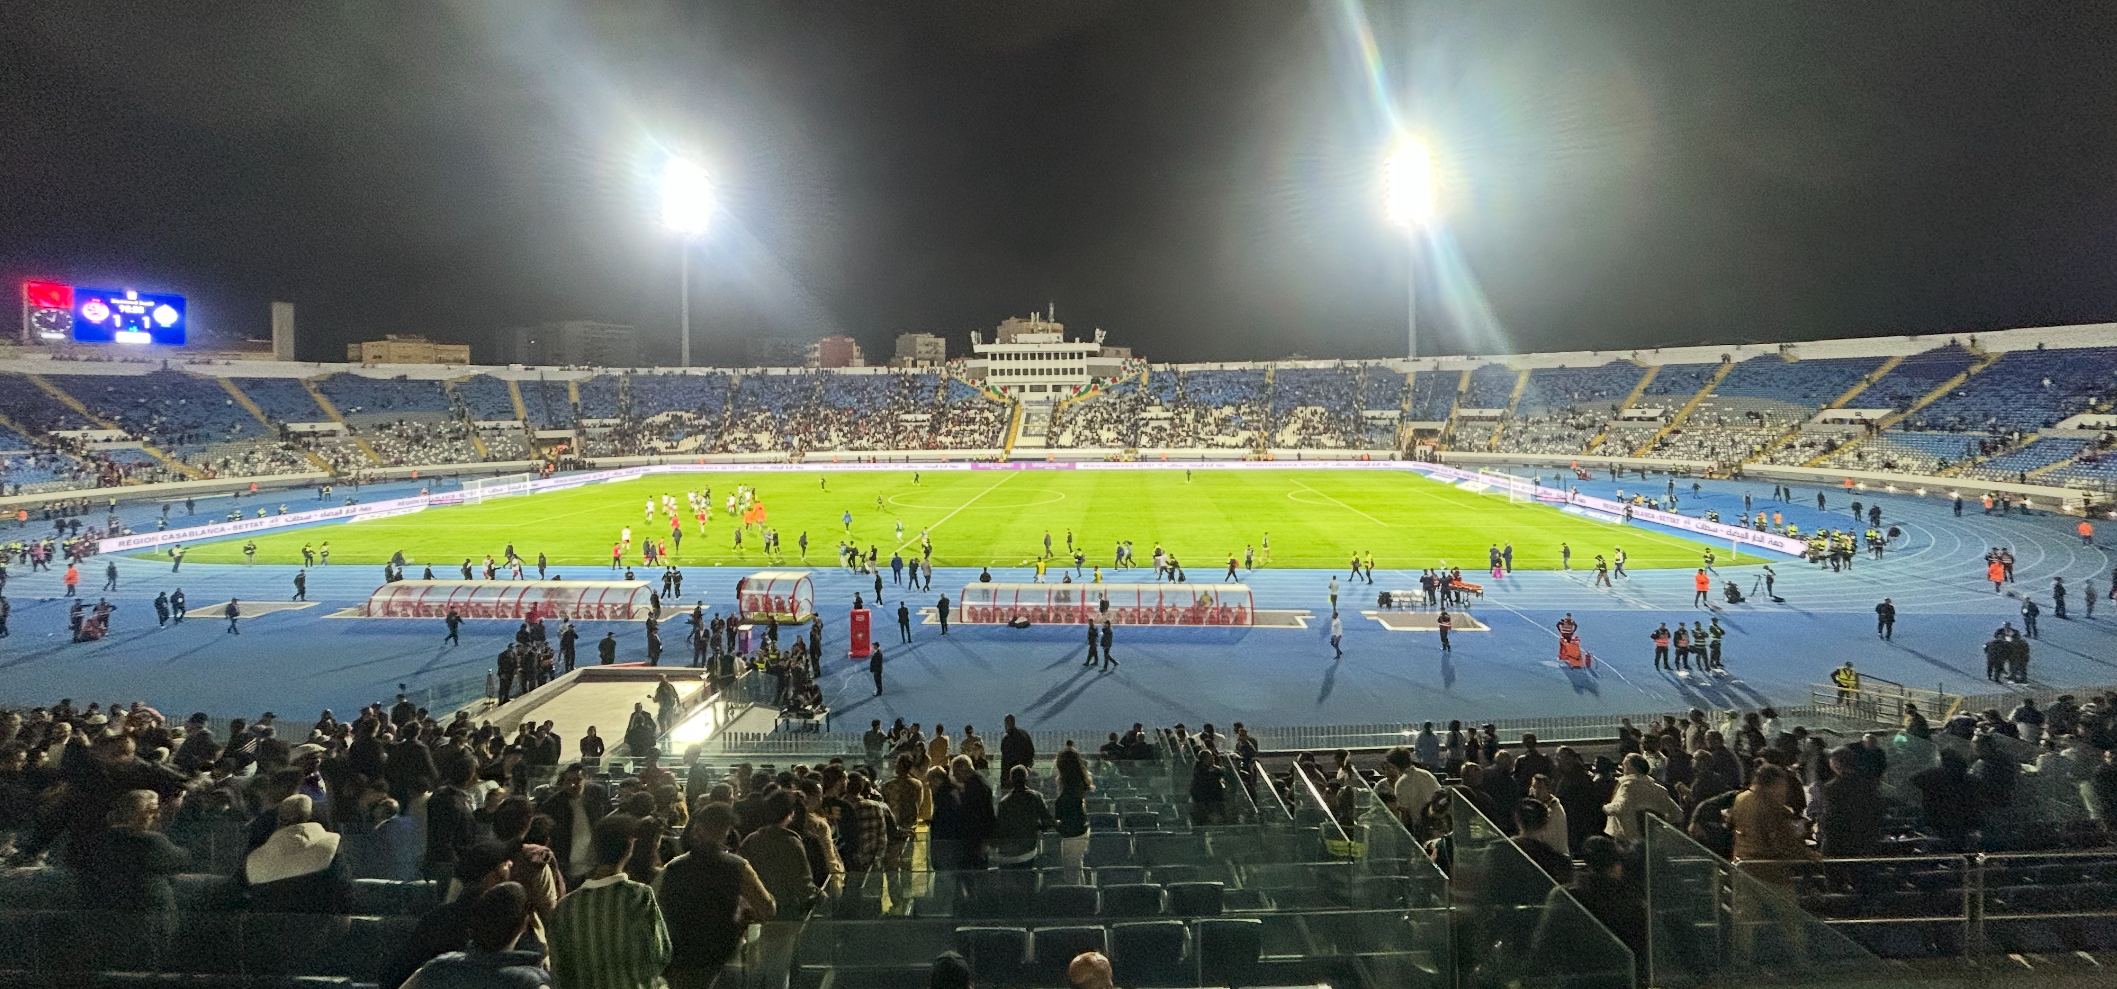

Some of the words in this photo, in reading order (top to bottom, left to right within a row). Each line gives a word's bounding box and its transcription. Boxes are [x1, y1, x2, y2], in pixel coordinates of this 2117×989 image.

[113, 314, 121, 328] 1
[142, 316, 150, 329] 1
[118, 535, 159, 548] RÉGION
[161, 526, 226, 541] CASABLANCA
[232, 521, 264, 531] SETTAT
